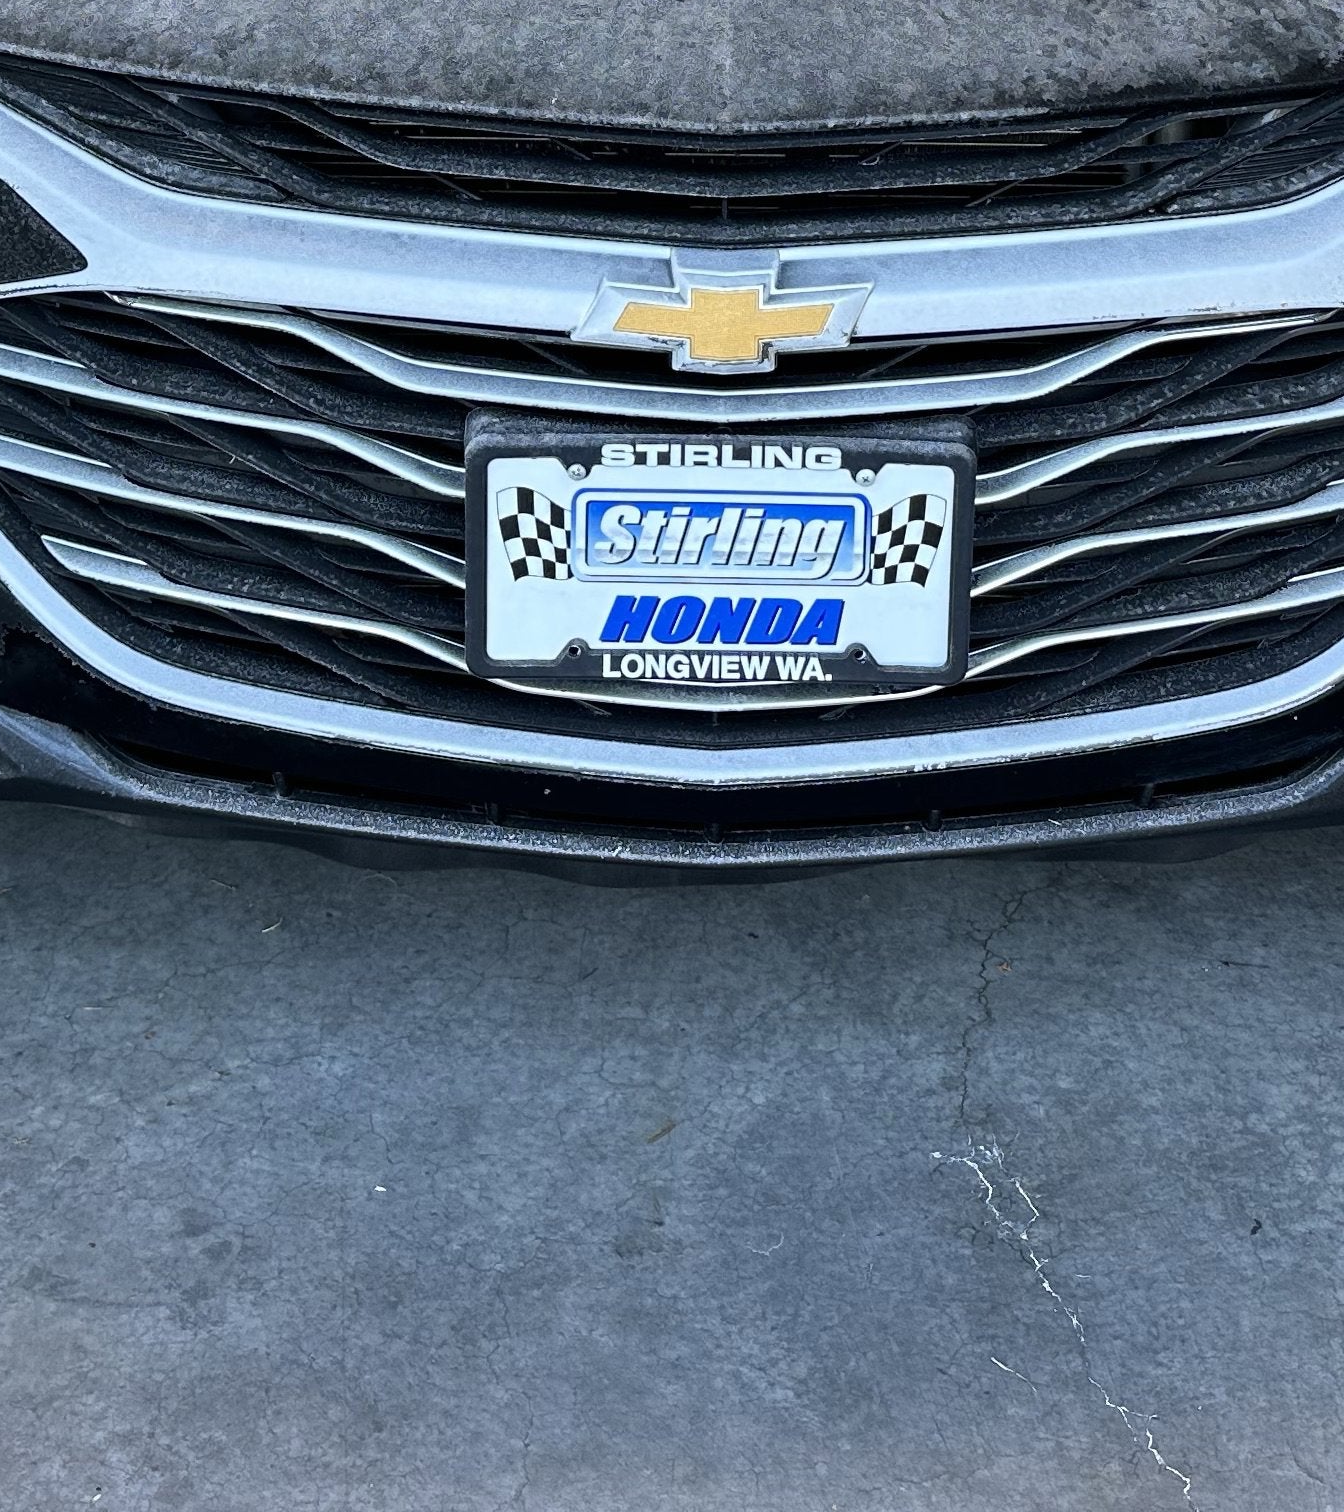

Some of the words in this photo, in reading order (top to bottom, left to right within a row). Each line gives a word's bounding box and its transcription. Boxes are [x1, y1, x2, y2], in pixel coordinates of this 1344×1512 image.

[601, 442, 843, 472] STIRLING
[593, 504, 848, 580] Stirling
[598, 595, 845, 646] HONDA
[601, 653, 772, 680] LONGVIEW
[774, 655, 833, 682] WA.
